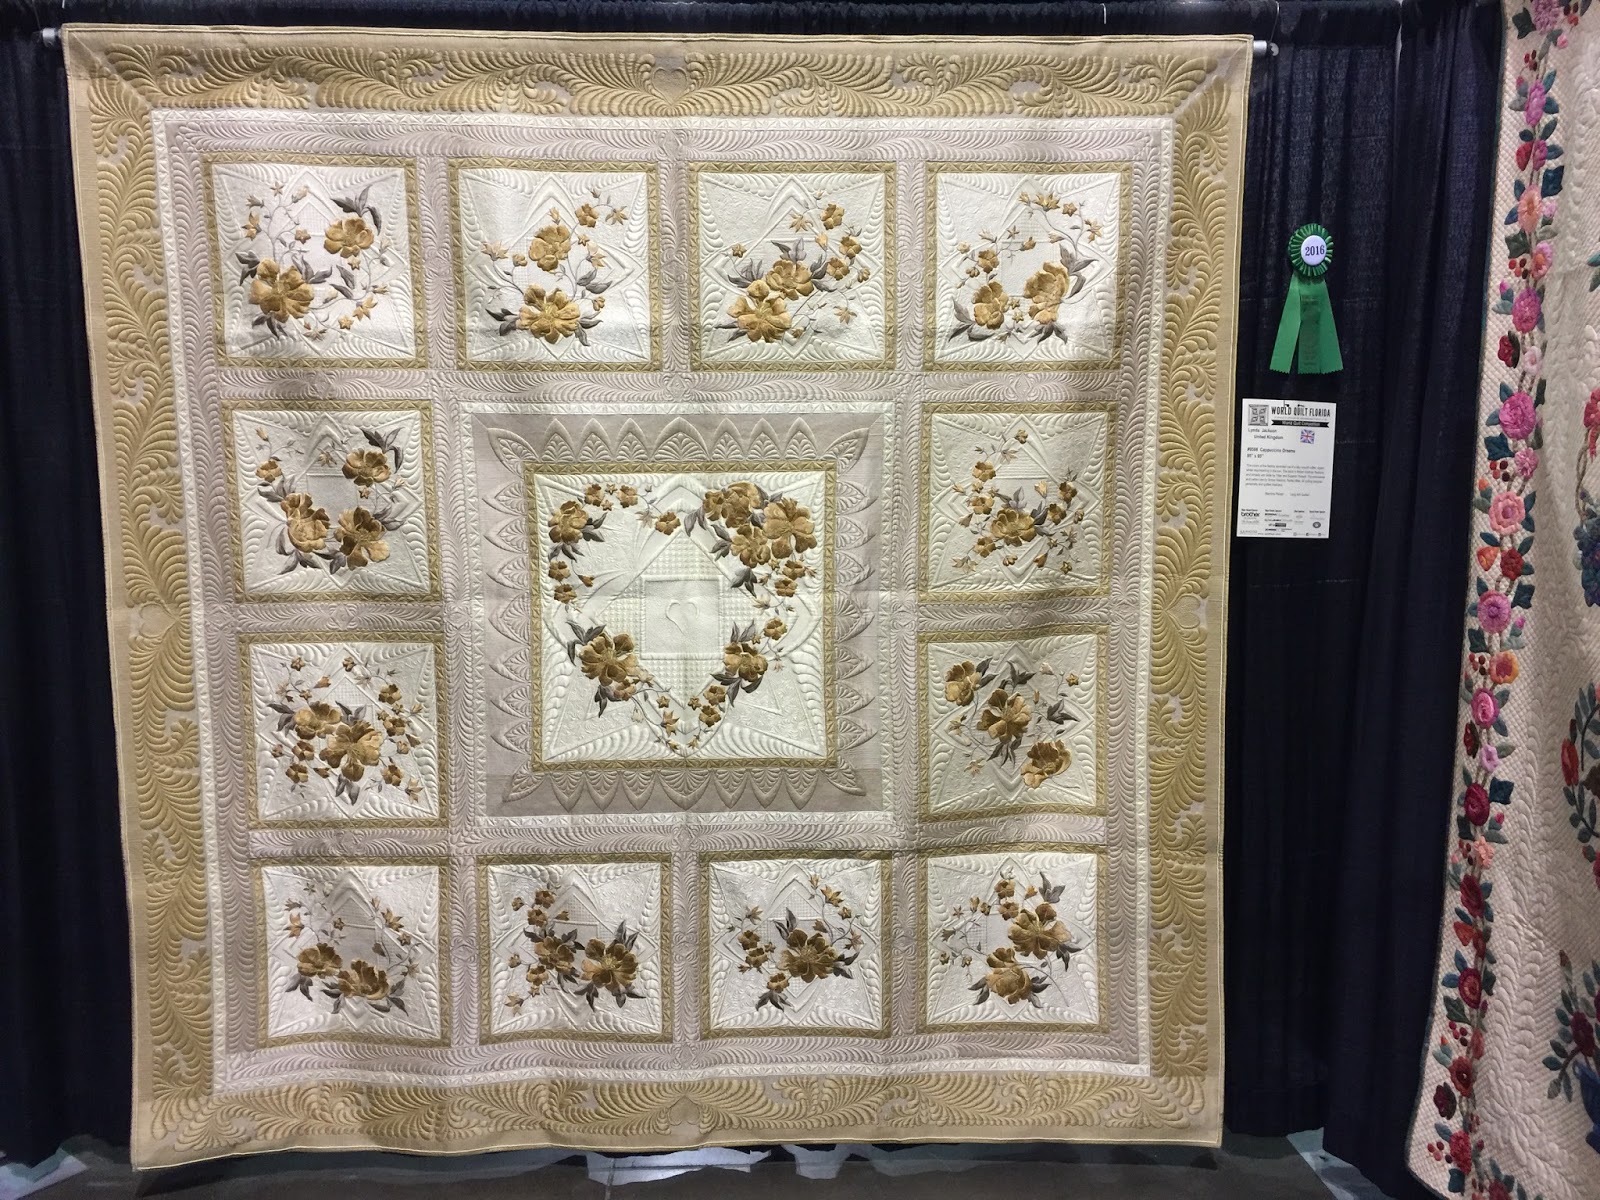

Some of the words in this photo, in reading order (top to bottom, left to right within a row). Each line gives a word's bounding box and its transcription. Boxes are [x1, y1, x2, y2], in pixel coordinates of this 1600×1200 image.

[1305, 245, 1325, 256] 2016
[1271, 406, 1292, 415] WORLD
[1294, 407, 1309, 416] QUILT
[1309, 408, 1331, 417] FLORIDA
